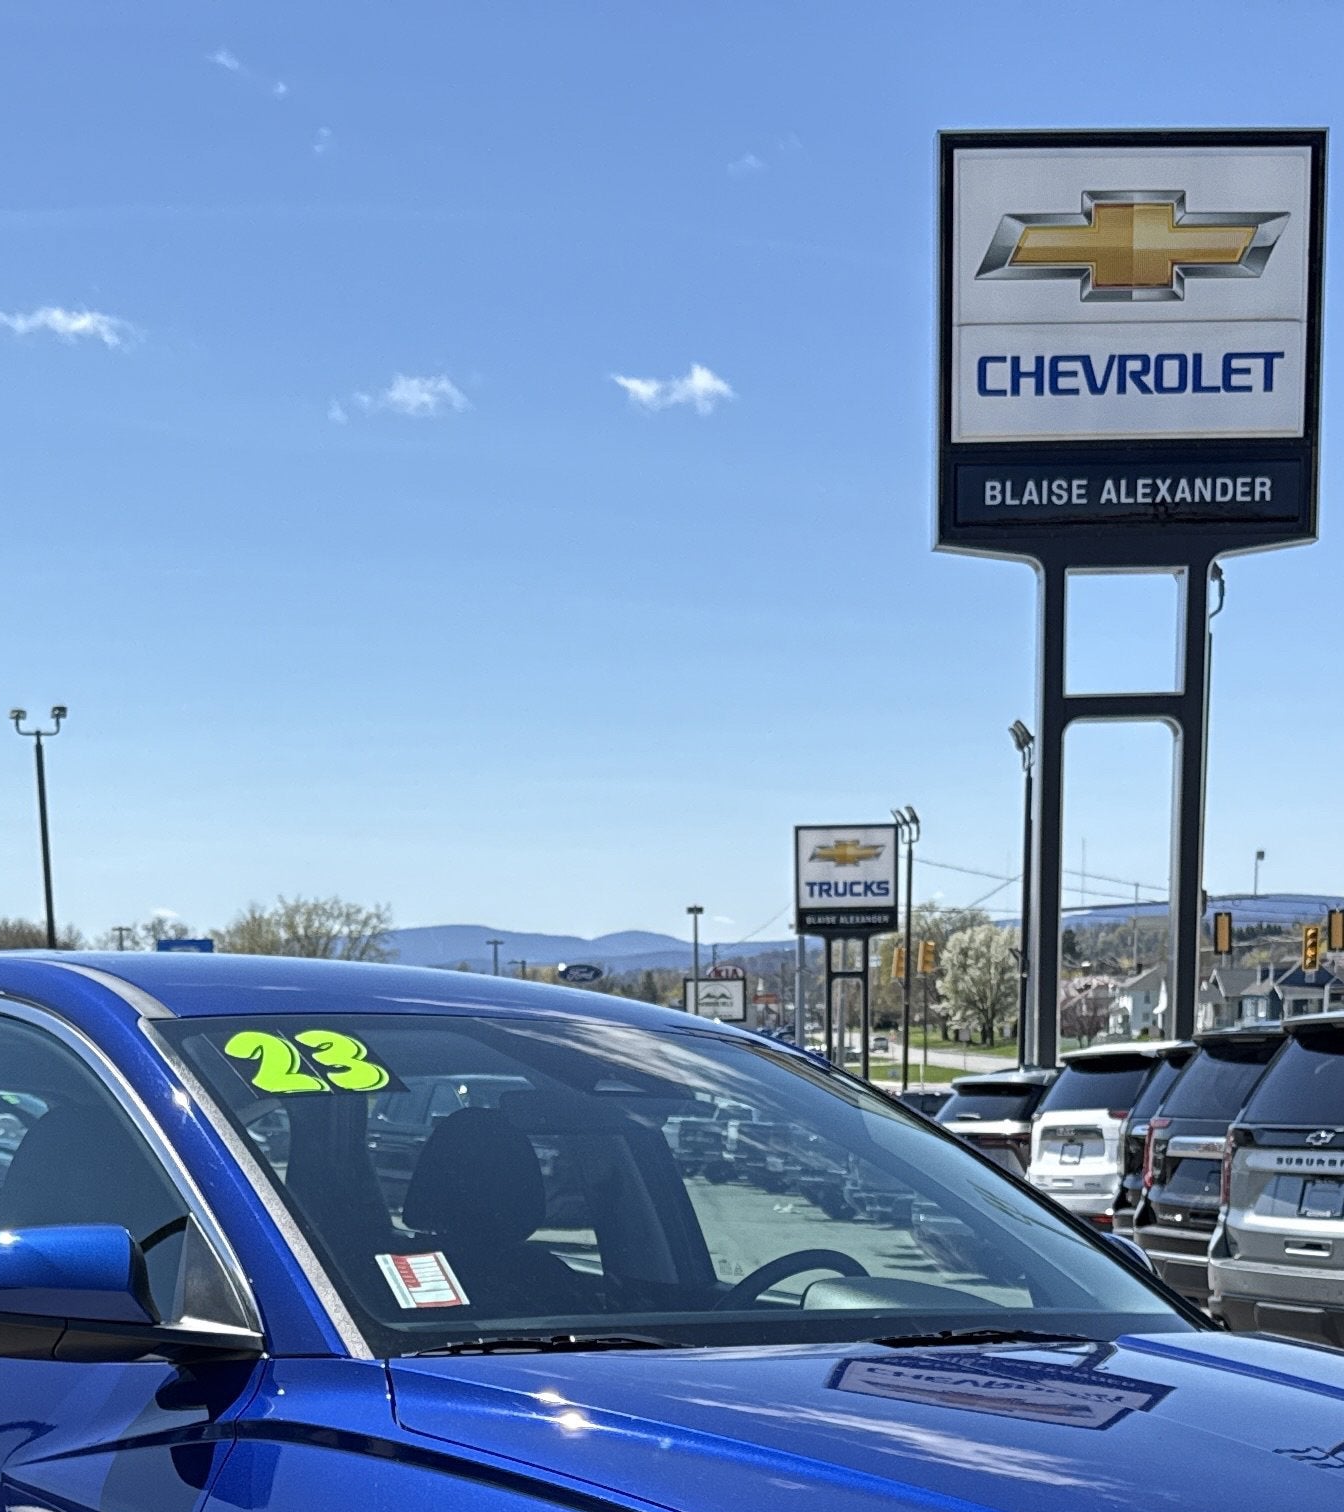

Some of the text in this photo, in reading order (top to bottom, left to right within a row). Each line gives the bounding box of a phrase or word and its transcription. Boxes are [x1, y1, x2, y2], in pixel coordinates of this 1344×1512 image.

[976, 351, 1285, 397] CHEVROLET
[984, 477, 1272, 506] BLAISE ALEXANDER
[805, 880, 890, 898] TRUCKS
[224, 1030, 390, 1093] 23
